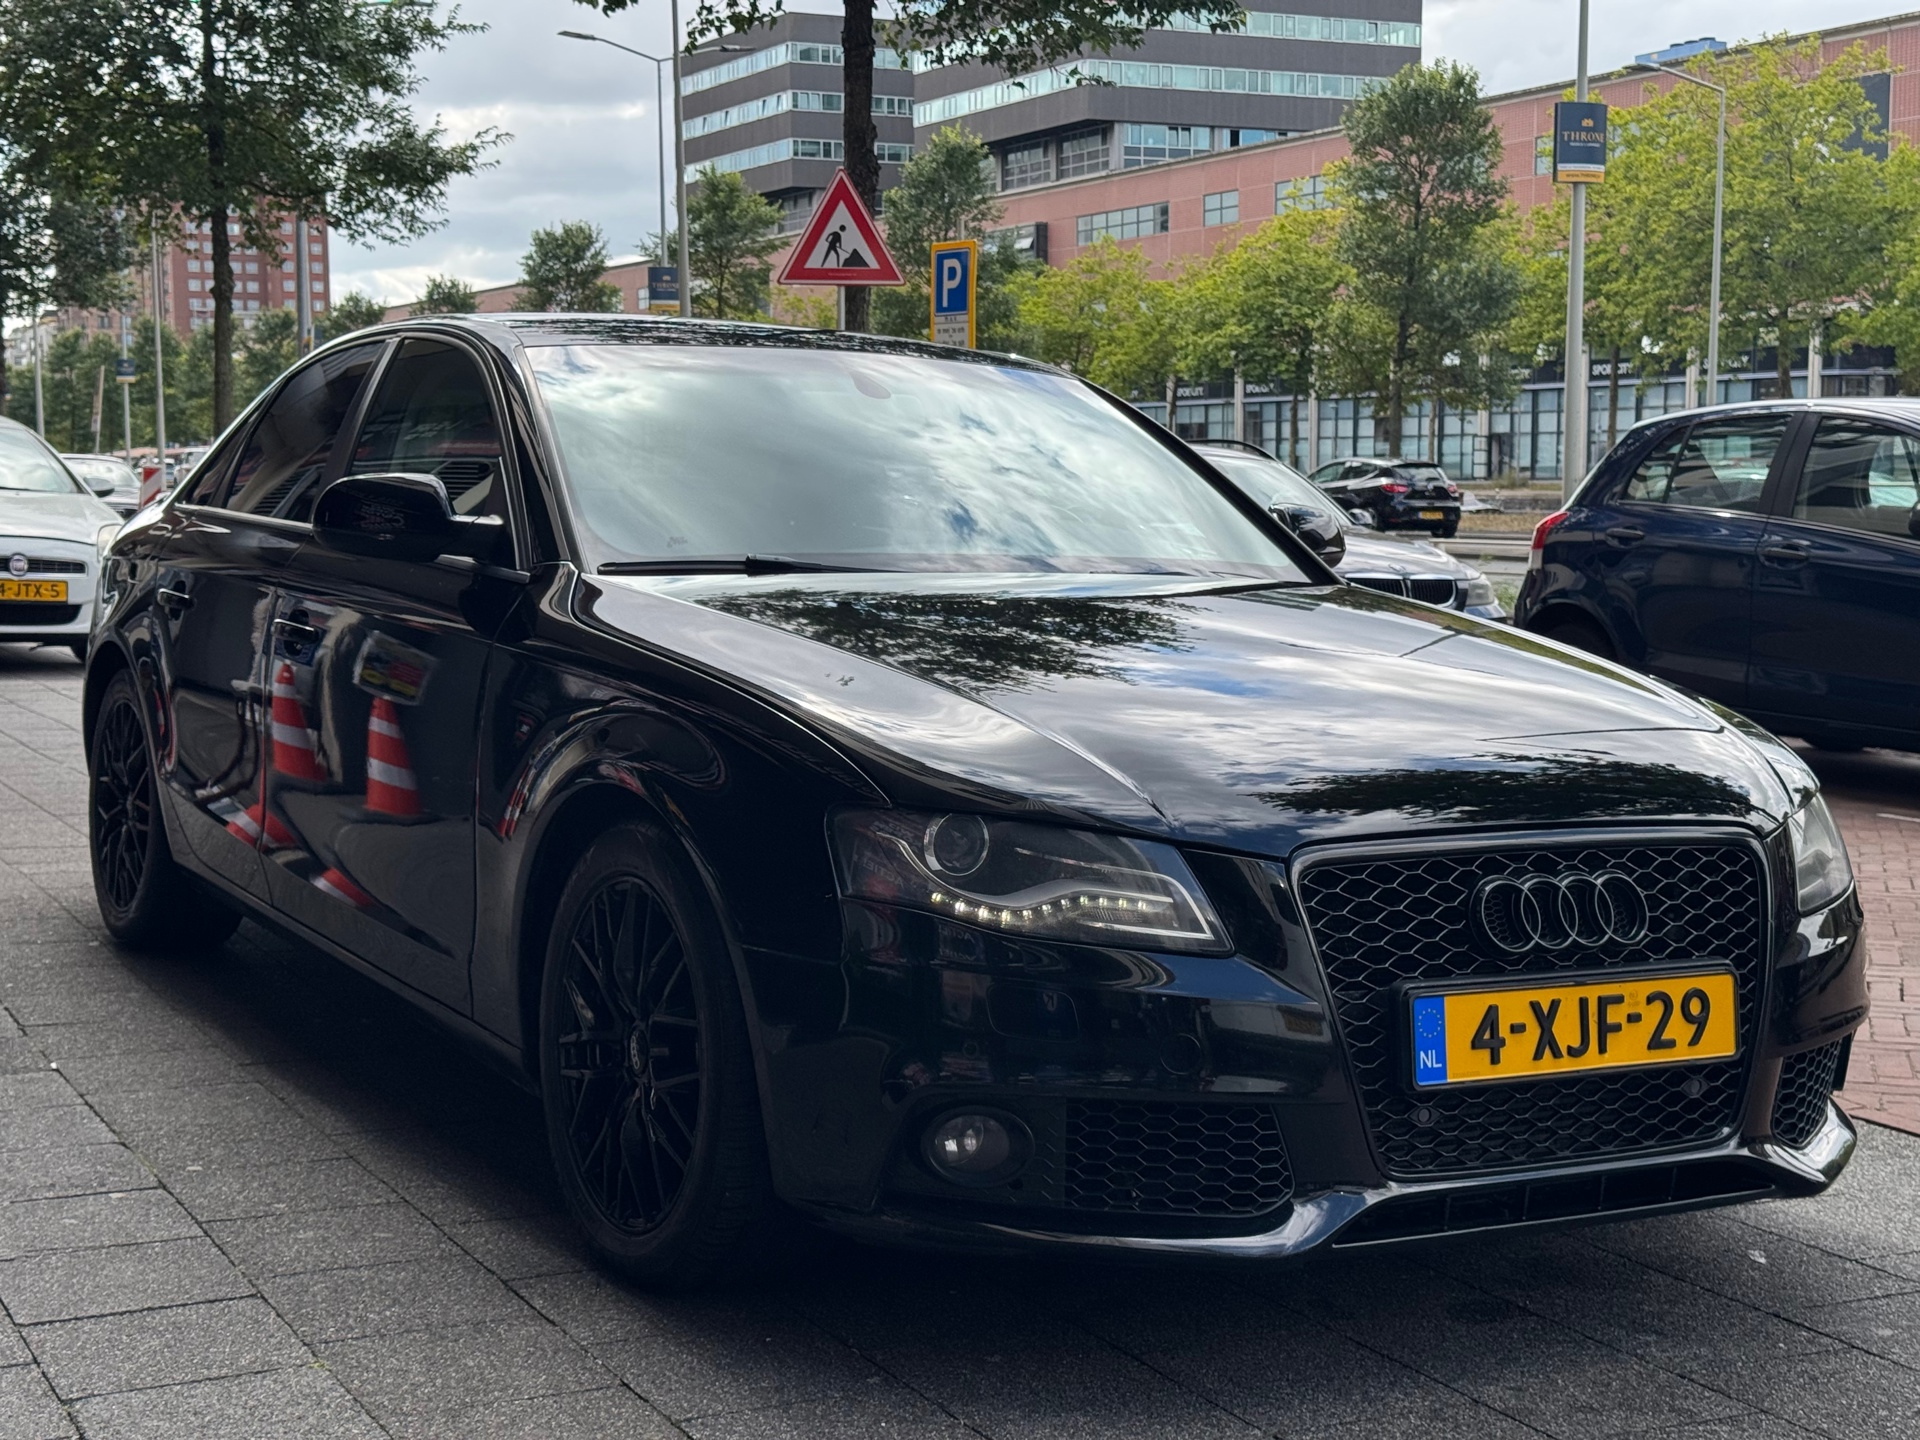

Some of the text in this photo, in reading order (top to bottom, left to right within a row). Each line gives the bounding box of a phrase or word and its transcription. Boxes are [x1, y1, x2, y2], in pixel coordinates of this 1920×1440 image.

[1562, 131, 1605, 143] THRONE
[943, 259, 962, 307] P
[1471, 987, 1711, 1065] 4-XJF-29
[1420, 1050, 1442, 1069] NL
